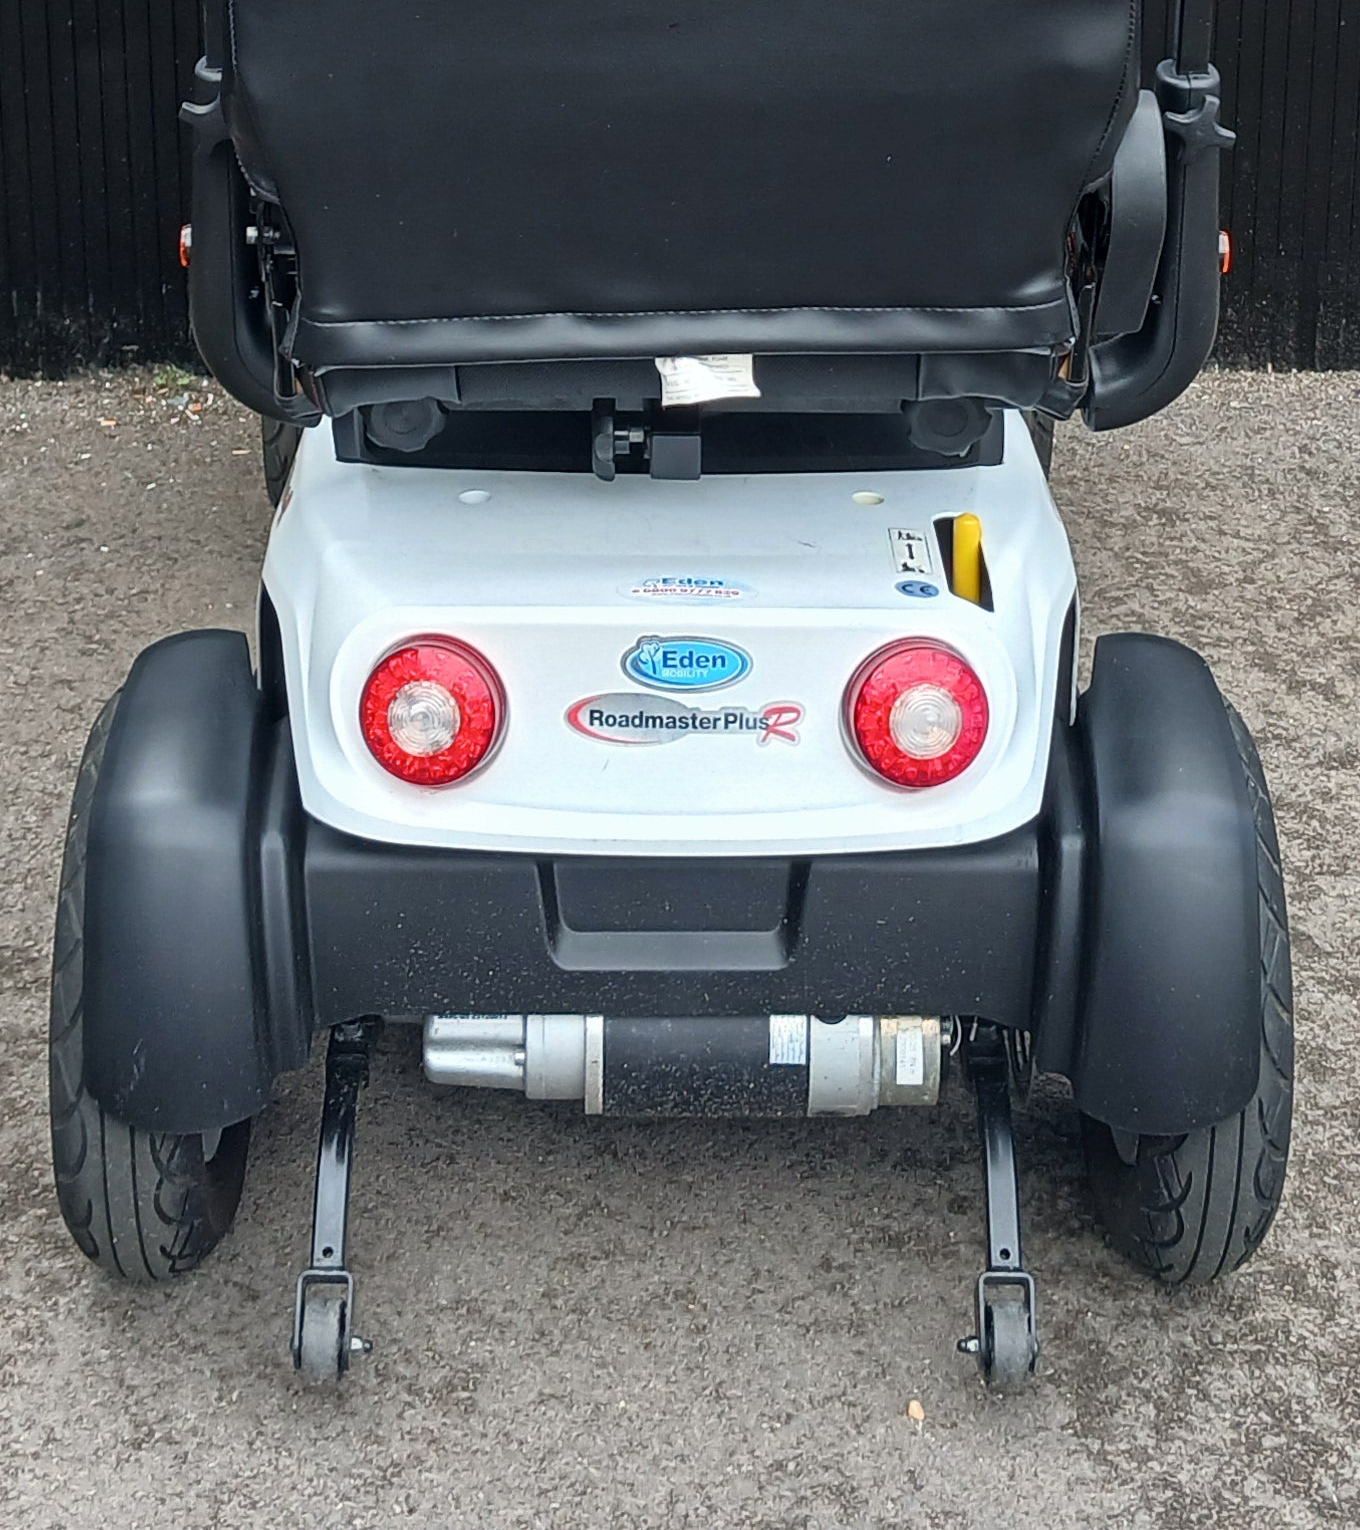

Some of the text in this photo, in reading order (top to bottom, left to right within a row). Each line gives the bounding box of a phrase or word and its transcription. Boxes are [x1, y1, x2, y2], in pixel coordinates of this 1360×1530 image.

[661, 577, 724, 587] Eden
[662, 650, 726, 668] Eden
[662, 669, 709, 678] MOBILITY
